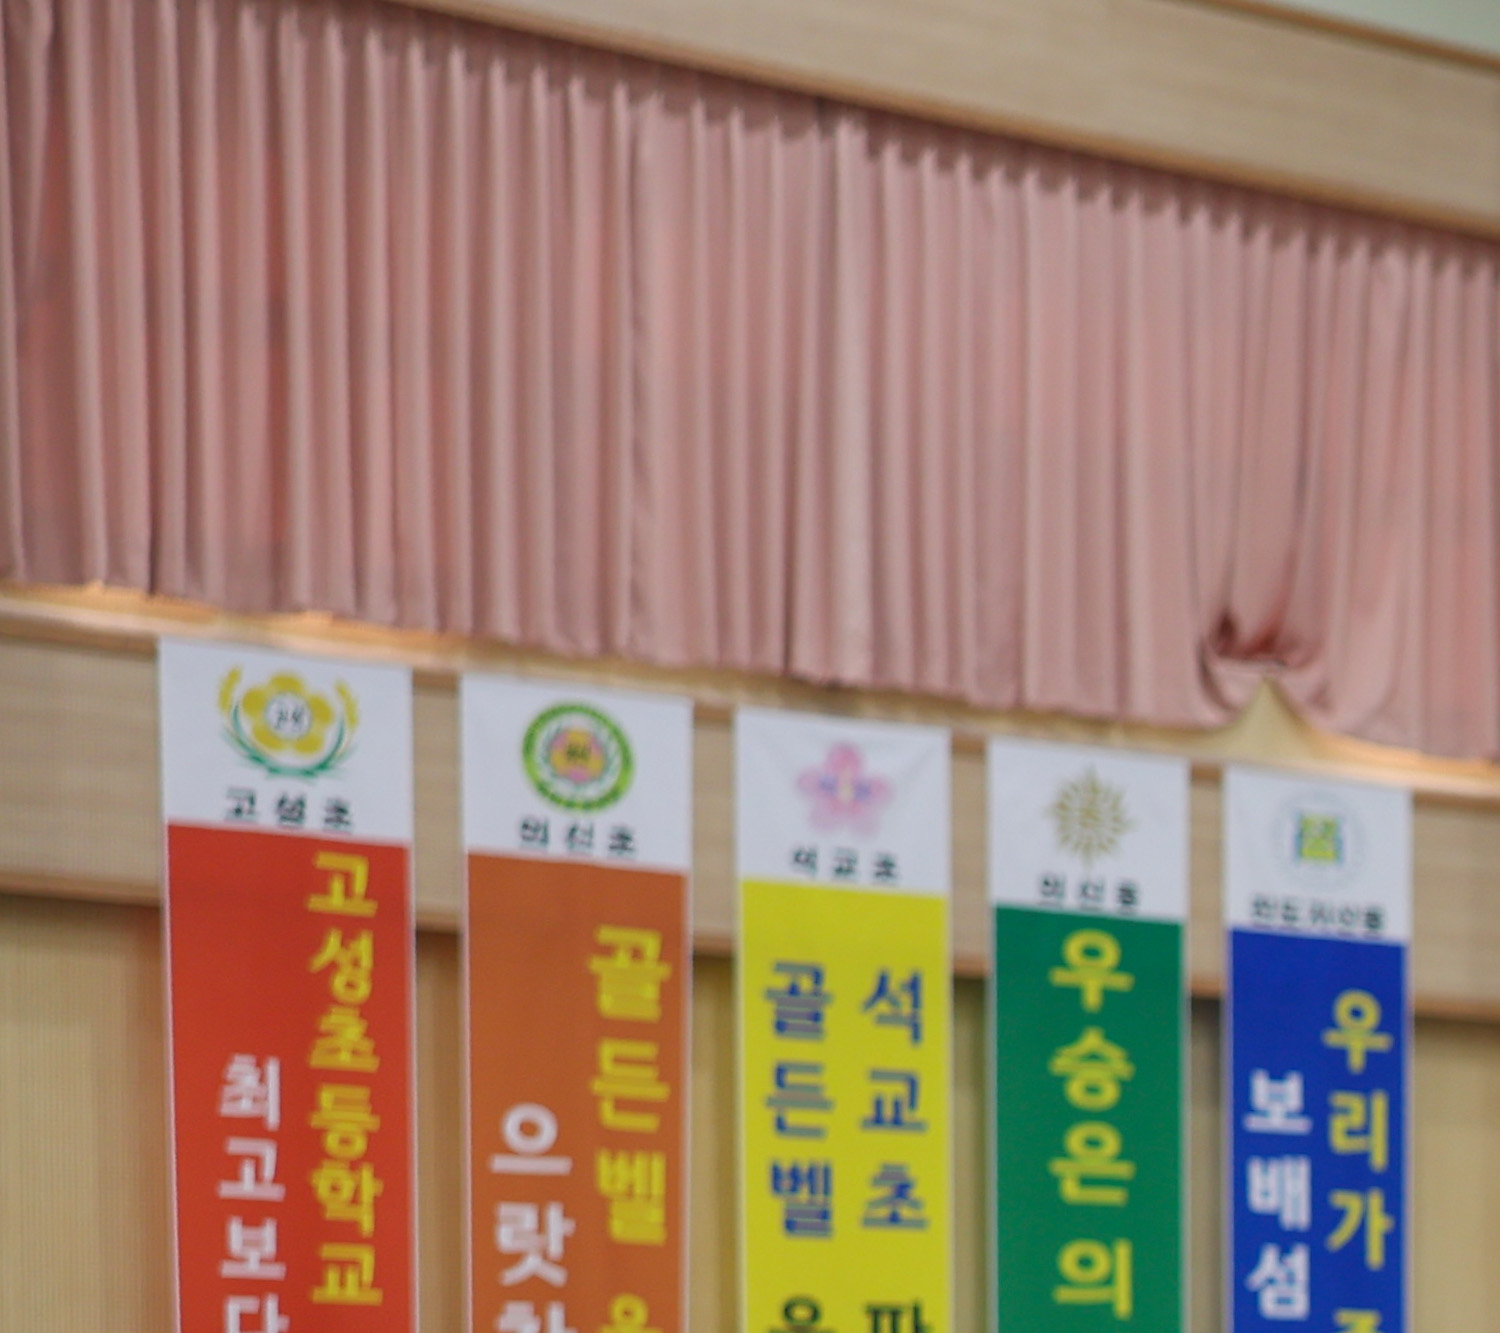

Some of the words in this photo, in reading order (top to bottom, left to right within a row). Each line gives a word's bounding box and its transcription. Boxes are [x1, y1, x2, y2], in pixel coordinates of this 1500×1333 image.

[307, 851, 383, 1304] 고성초등학교
[586, 924, 671, 1243] 골든벨
[764, 959, 834, 1239] 골든벨
[859, 965, 929, 1229] 석교초
[1048, 929, 1135, 1207] 우승은
[1243, 1068, 1312, 1322] 보배섬
[1322, 989, 1393, 1270] 우리가
